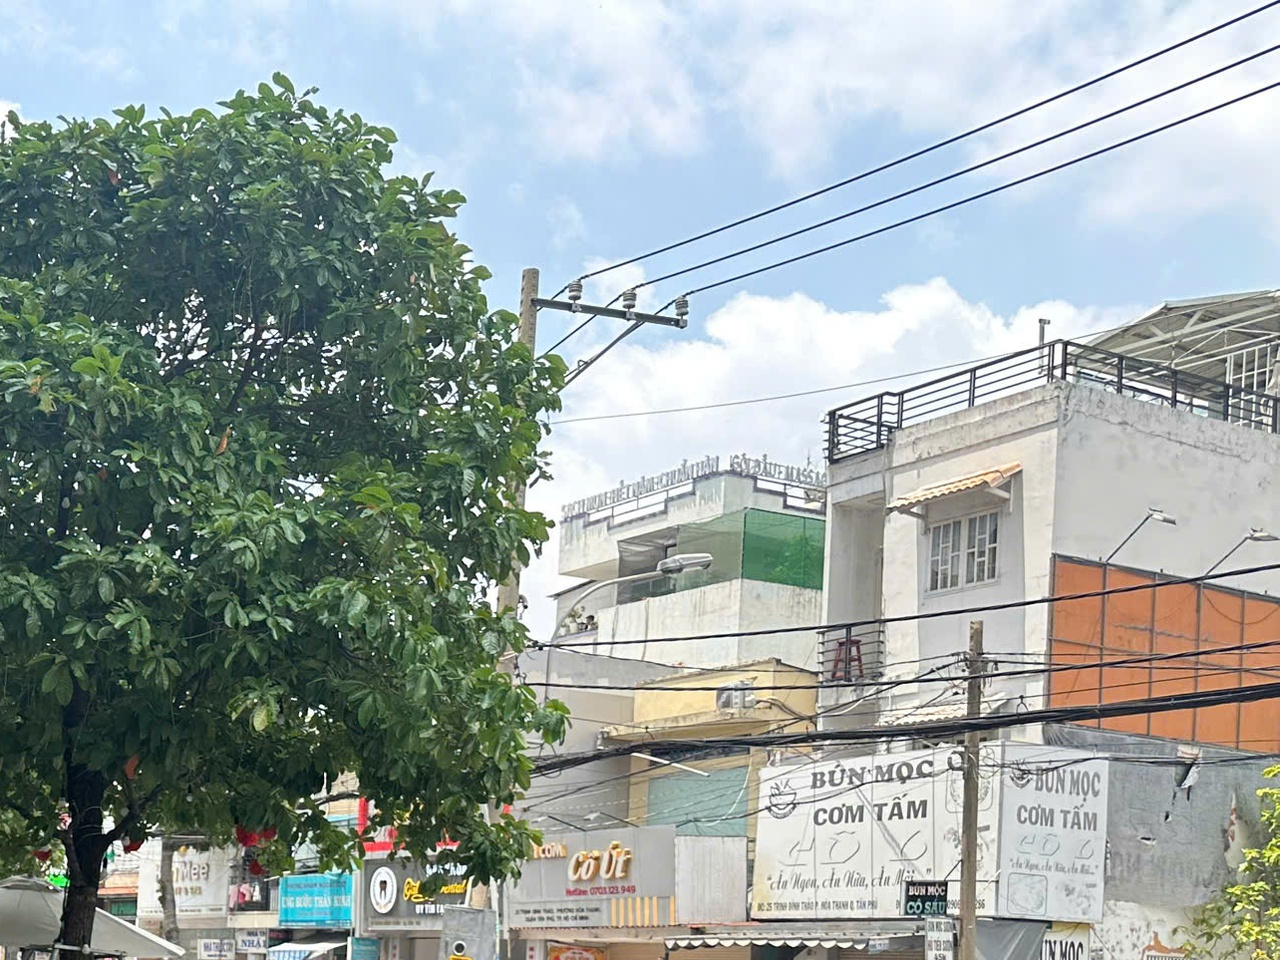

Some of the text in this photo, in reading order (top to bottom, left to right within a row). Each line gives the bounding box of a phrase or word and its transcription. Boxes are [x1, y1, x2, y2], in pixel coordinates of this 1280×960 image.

[810, 759, 934, 789] BÚN MỌC
[1070, 769, 1101, 802] MỌC
[813, 793, 928, 825] CƠM TẤM
[1017, 803, 1097, 831] CƠM TẤM
[907, 898, 923, 914] CÔ
[924, 899, 946, 914] SÁU
